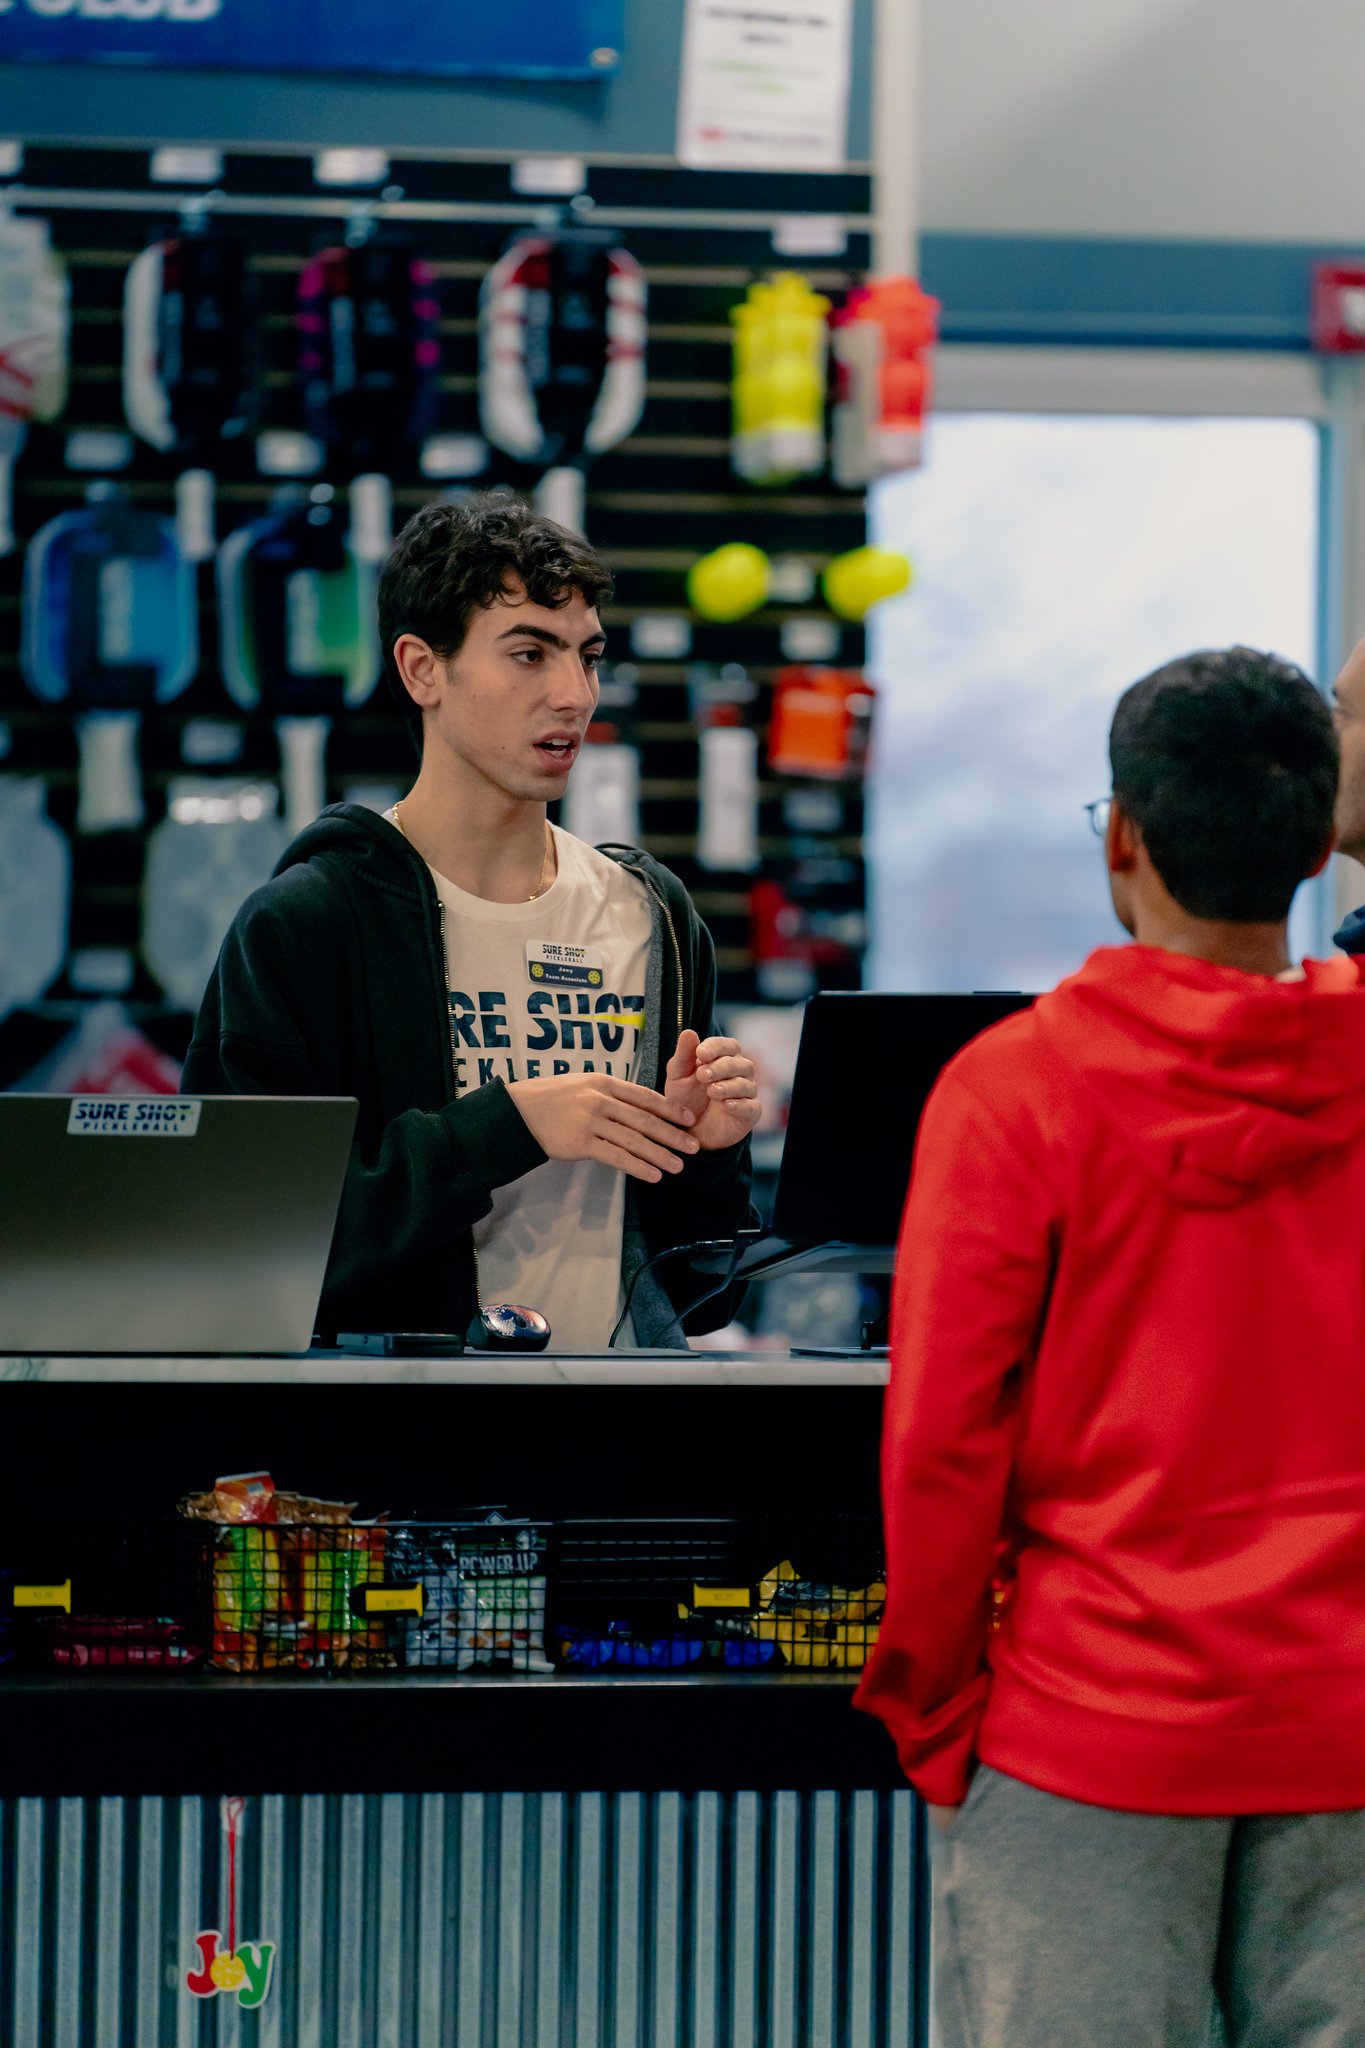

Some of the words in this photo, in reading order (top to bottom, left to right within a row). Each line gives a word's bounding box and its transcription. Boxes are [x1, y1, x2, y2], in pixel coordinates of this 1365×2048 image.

[542, 944, 563, 956] SURE
[564, 947, 585, 958] SHOT
[546, 955, 583, 963] PICKLEBALL
[561, 975, 588, 983] Associate
[450, 991, 511, 1049] RE
[75, 1103, 130, 1120] SURE
[135, 1104, 191, 1121] SHOT
[83, 1122, 179, 1132] PICKLEBALL
[187, 1932, 275, 2007] Joy
